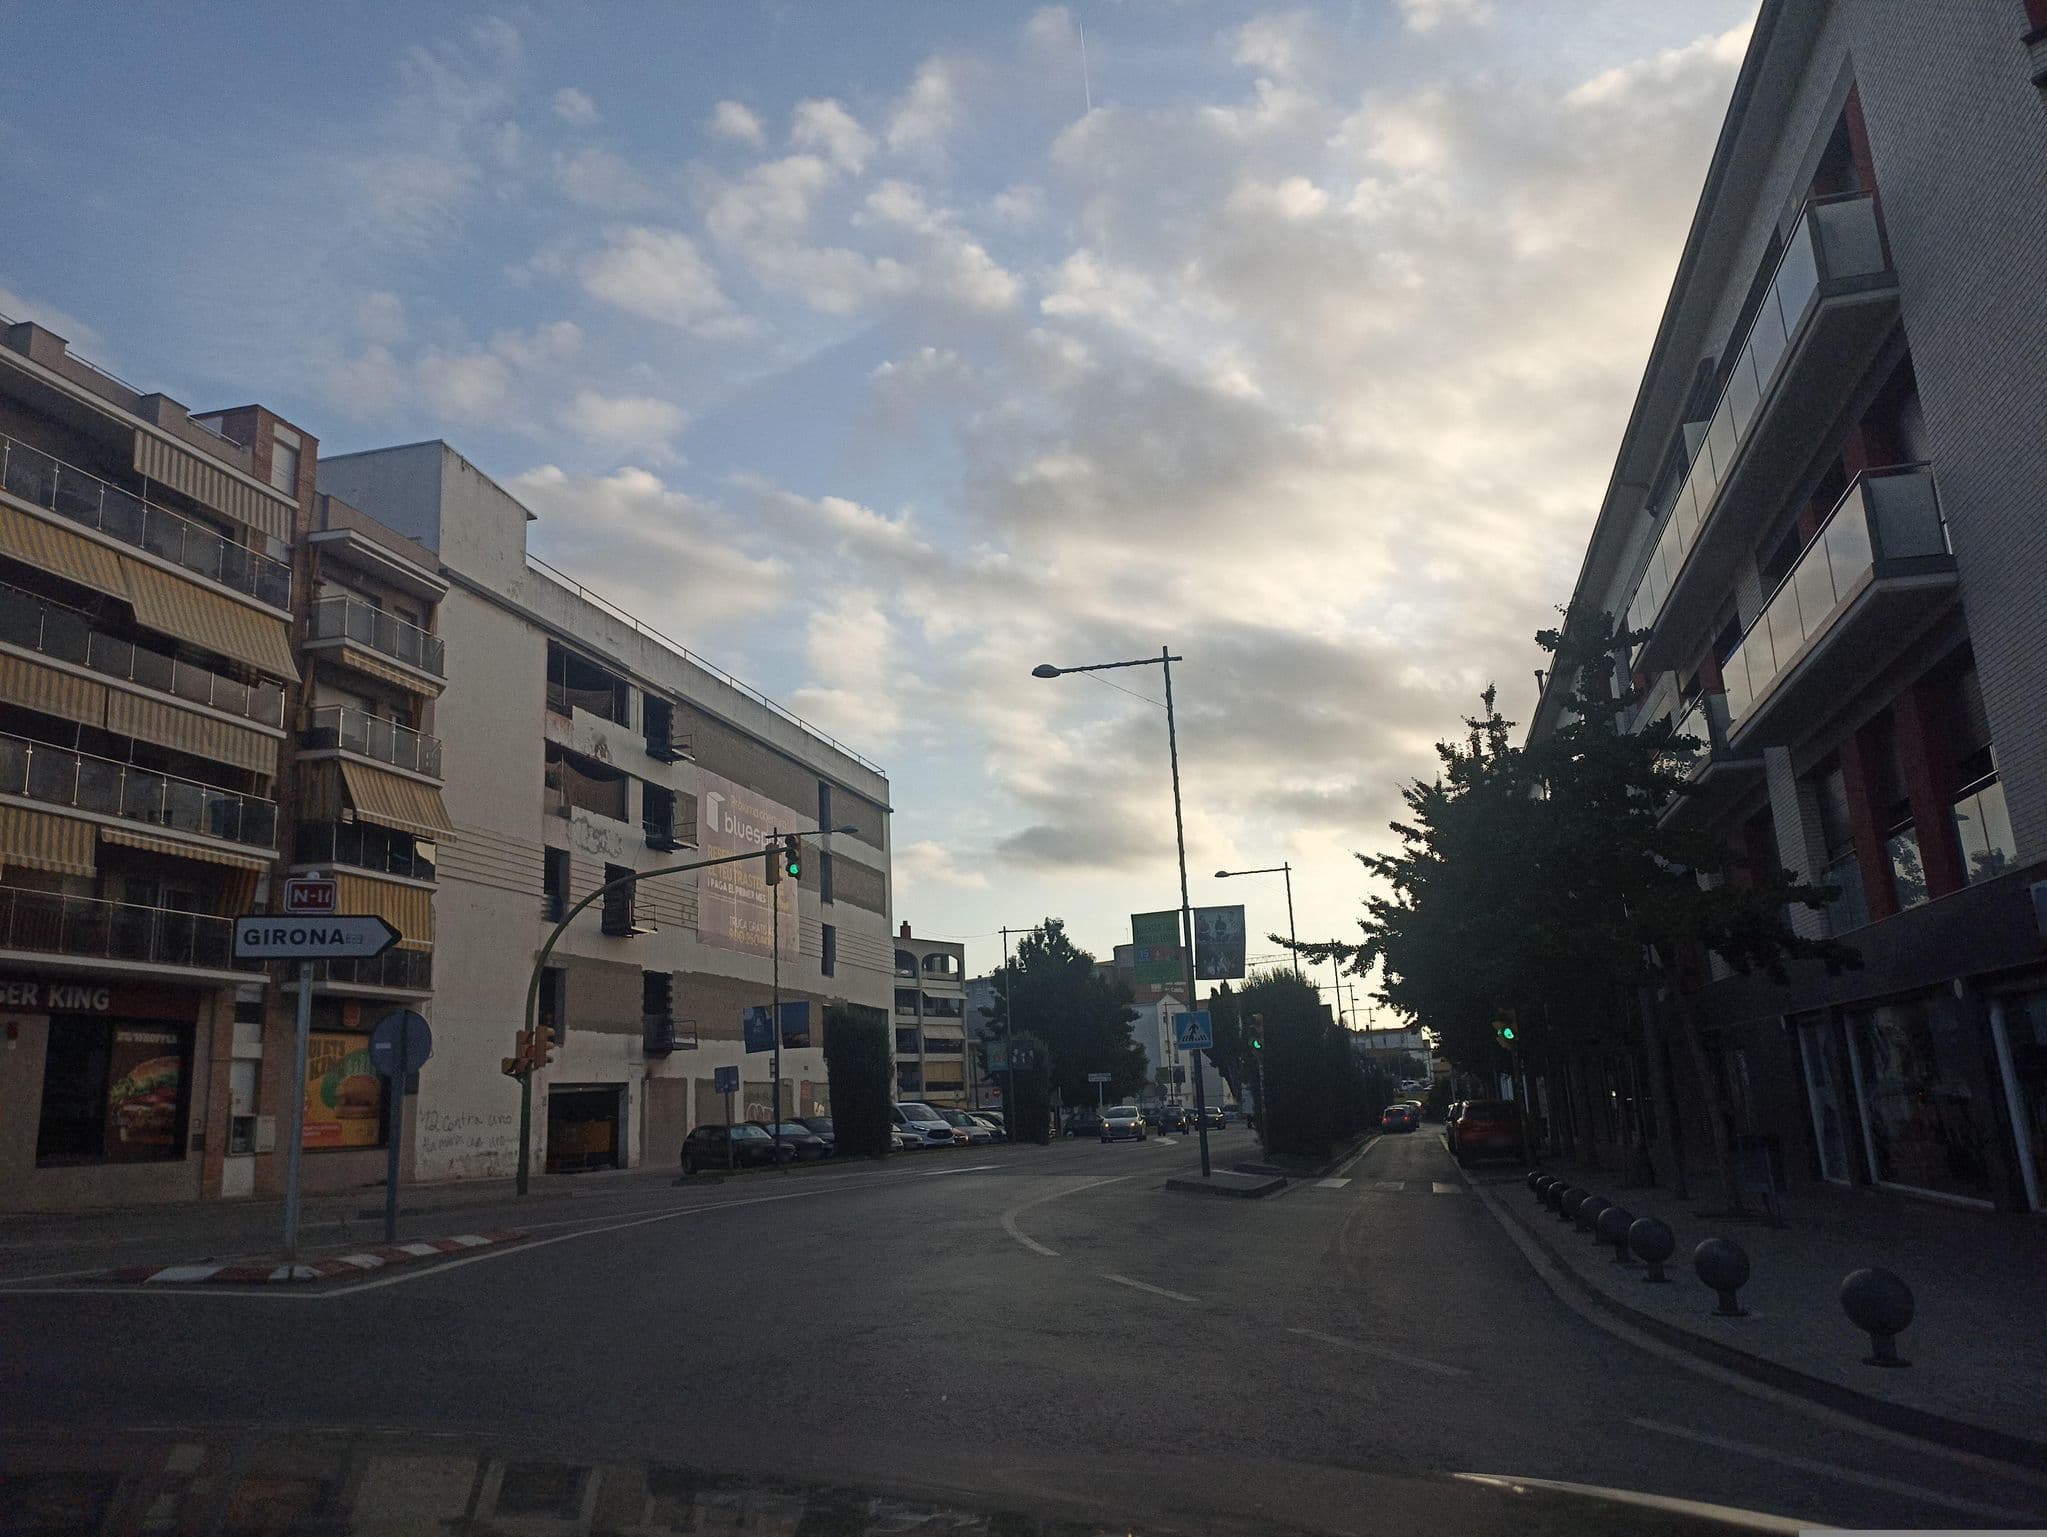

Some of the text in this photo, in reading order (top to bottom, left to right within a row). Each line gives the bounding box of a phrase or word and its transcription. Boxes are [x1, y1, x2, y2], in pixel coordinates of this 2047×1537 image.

[710, 879, 728, 892] PAGA
[728, 883, 735, 895] EL
[244, 929, 345, 945] GIRONA
[48, 985, 110, 1010] KING
